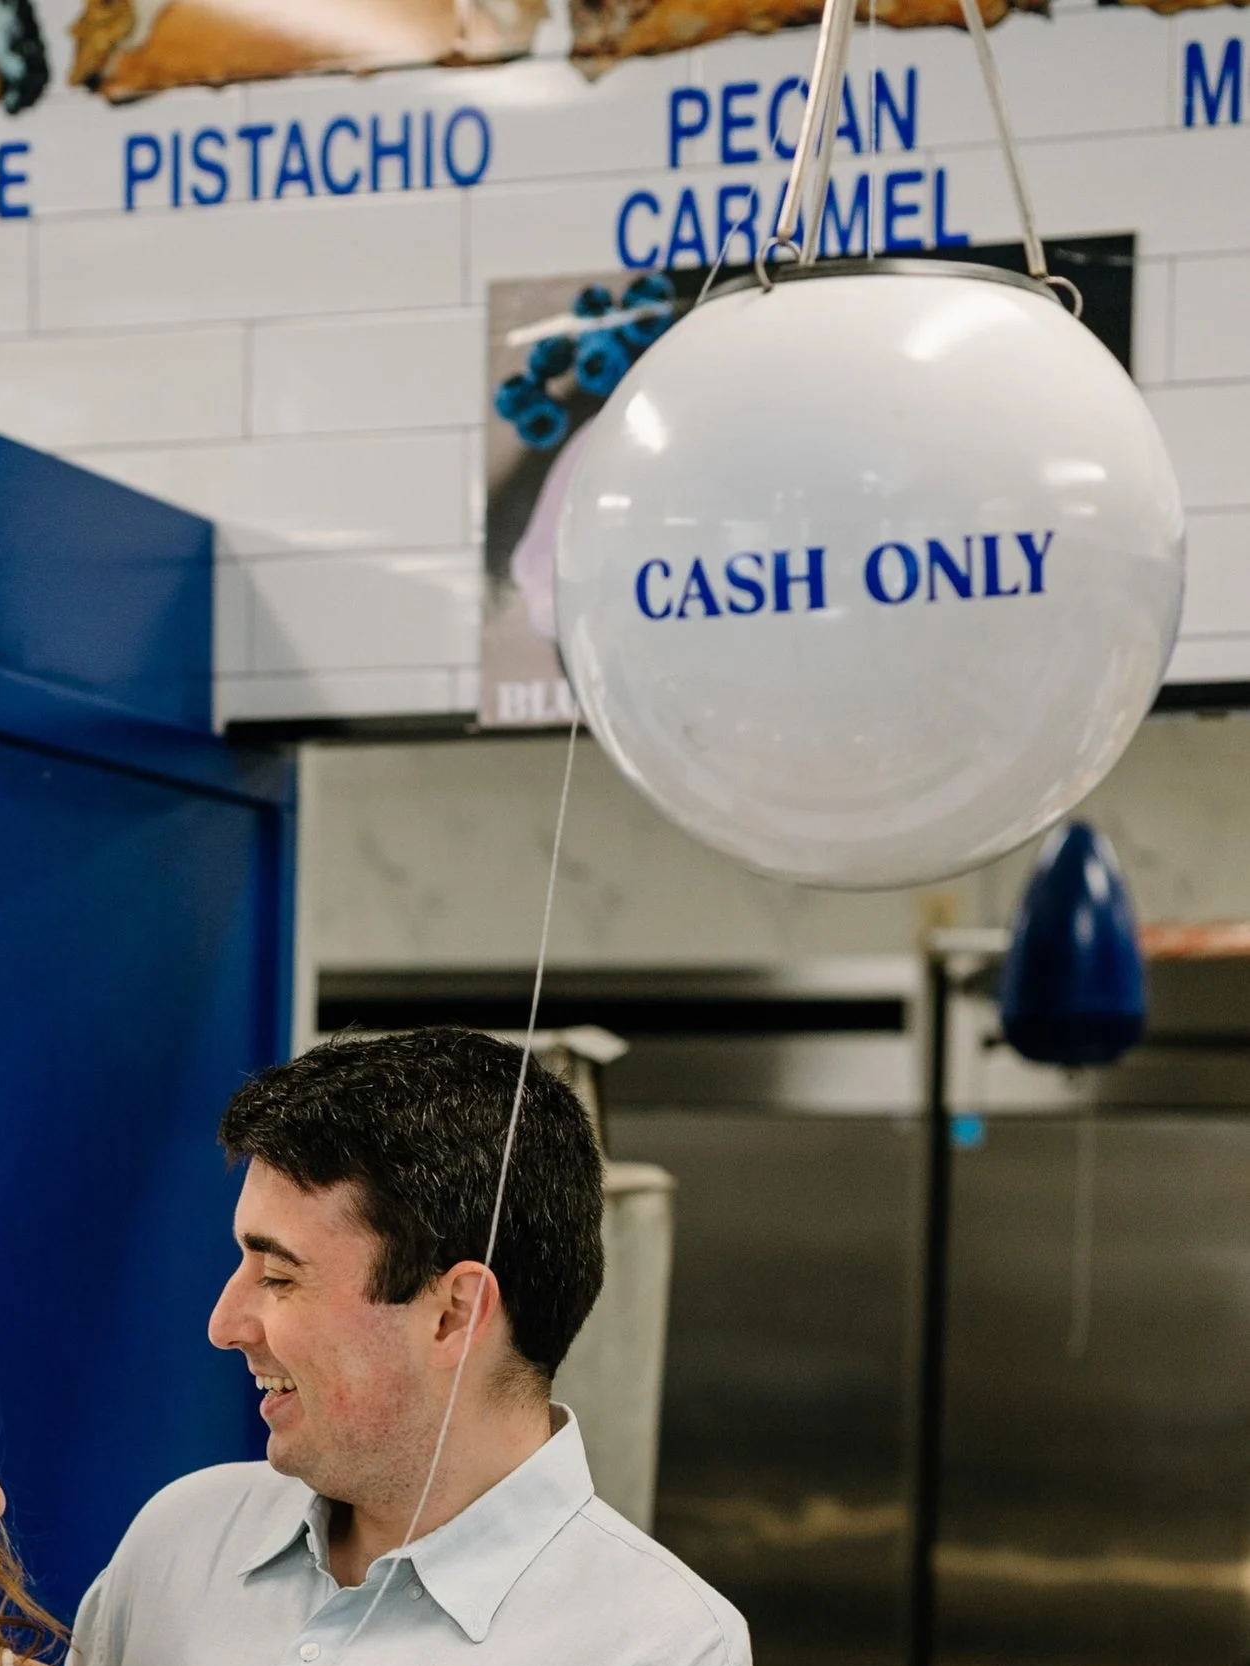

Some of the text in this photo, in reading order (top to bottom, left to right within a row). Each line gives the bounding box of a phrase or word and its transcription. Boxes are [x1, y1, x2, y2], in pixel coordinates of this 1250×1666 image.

[124, 107, 491, 213] PISTACHIO
[667, 66, 919, 170] PECAN
[615, 167, 971, 270] CARAMEL
[636, 531, 1055, 619] CASH ONLY
